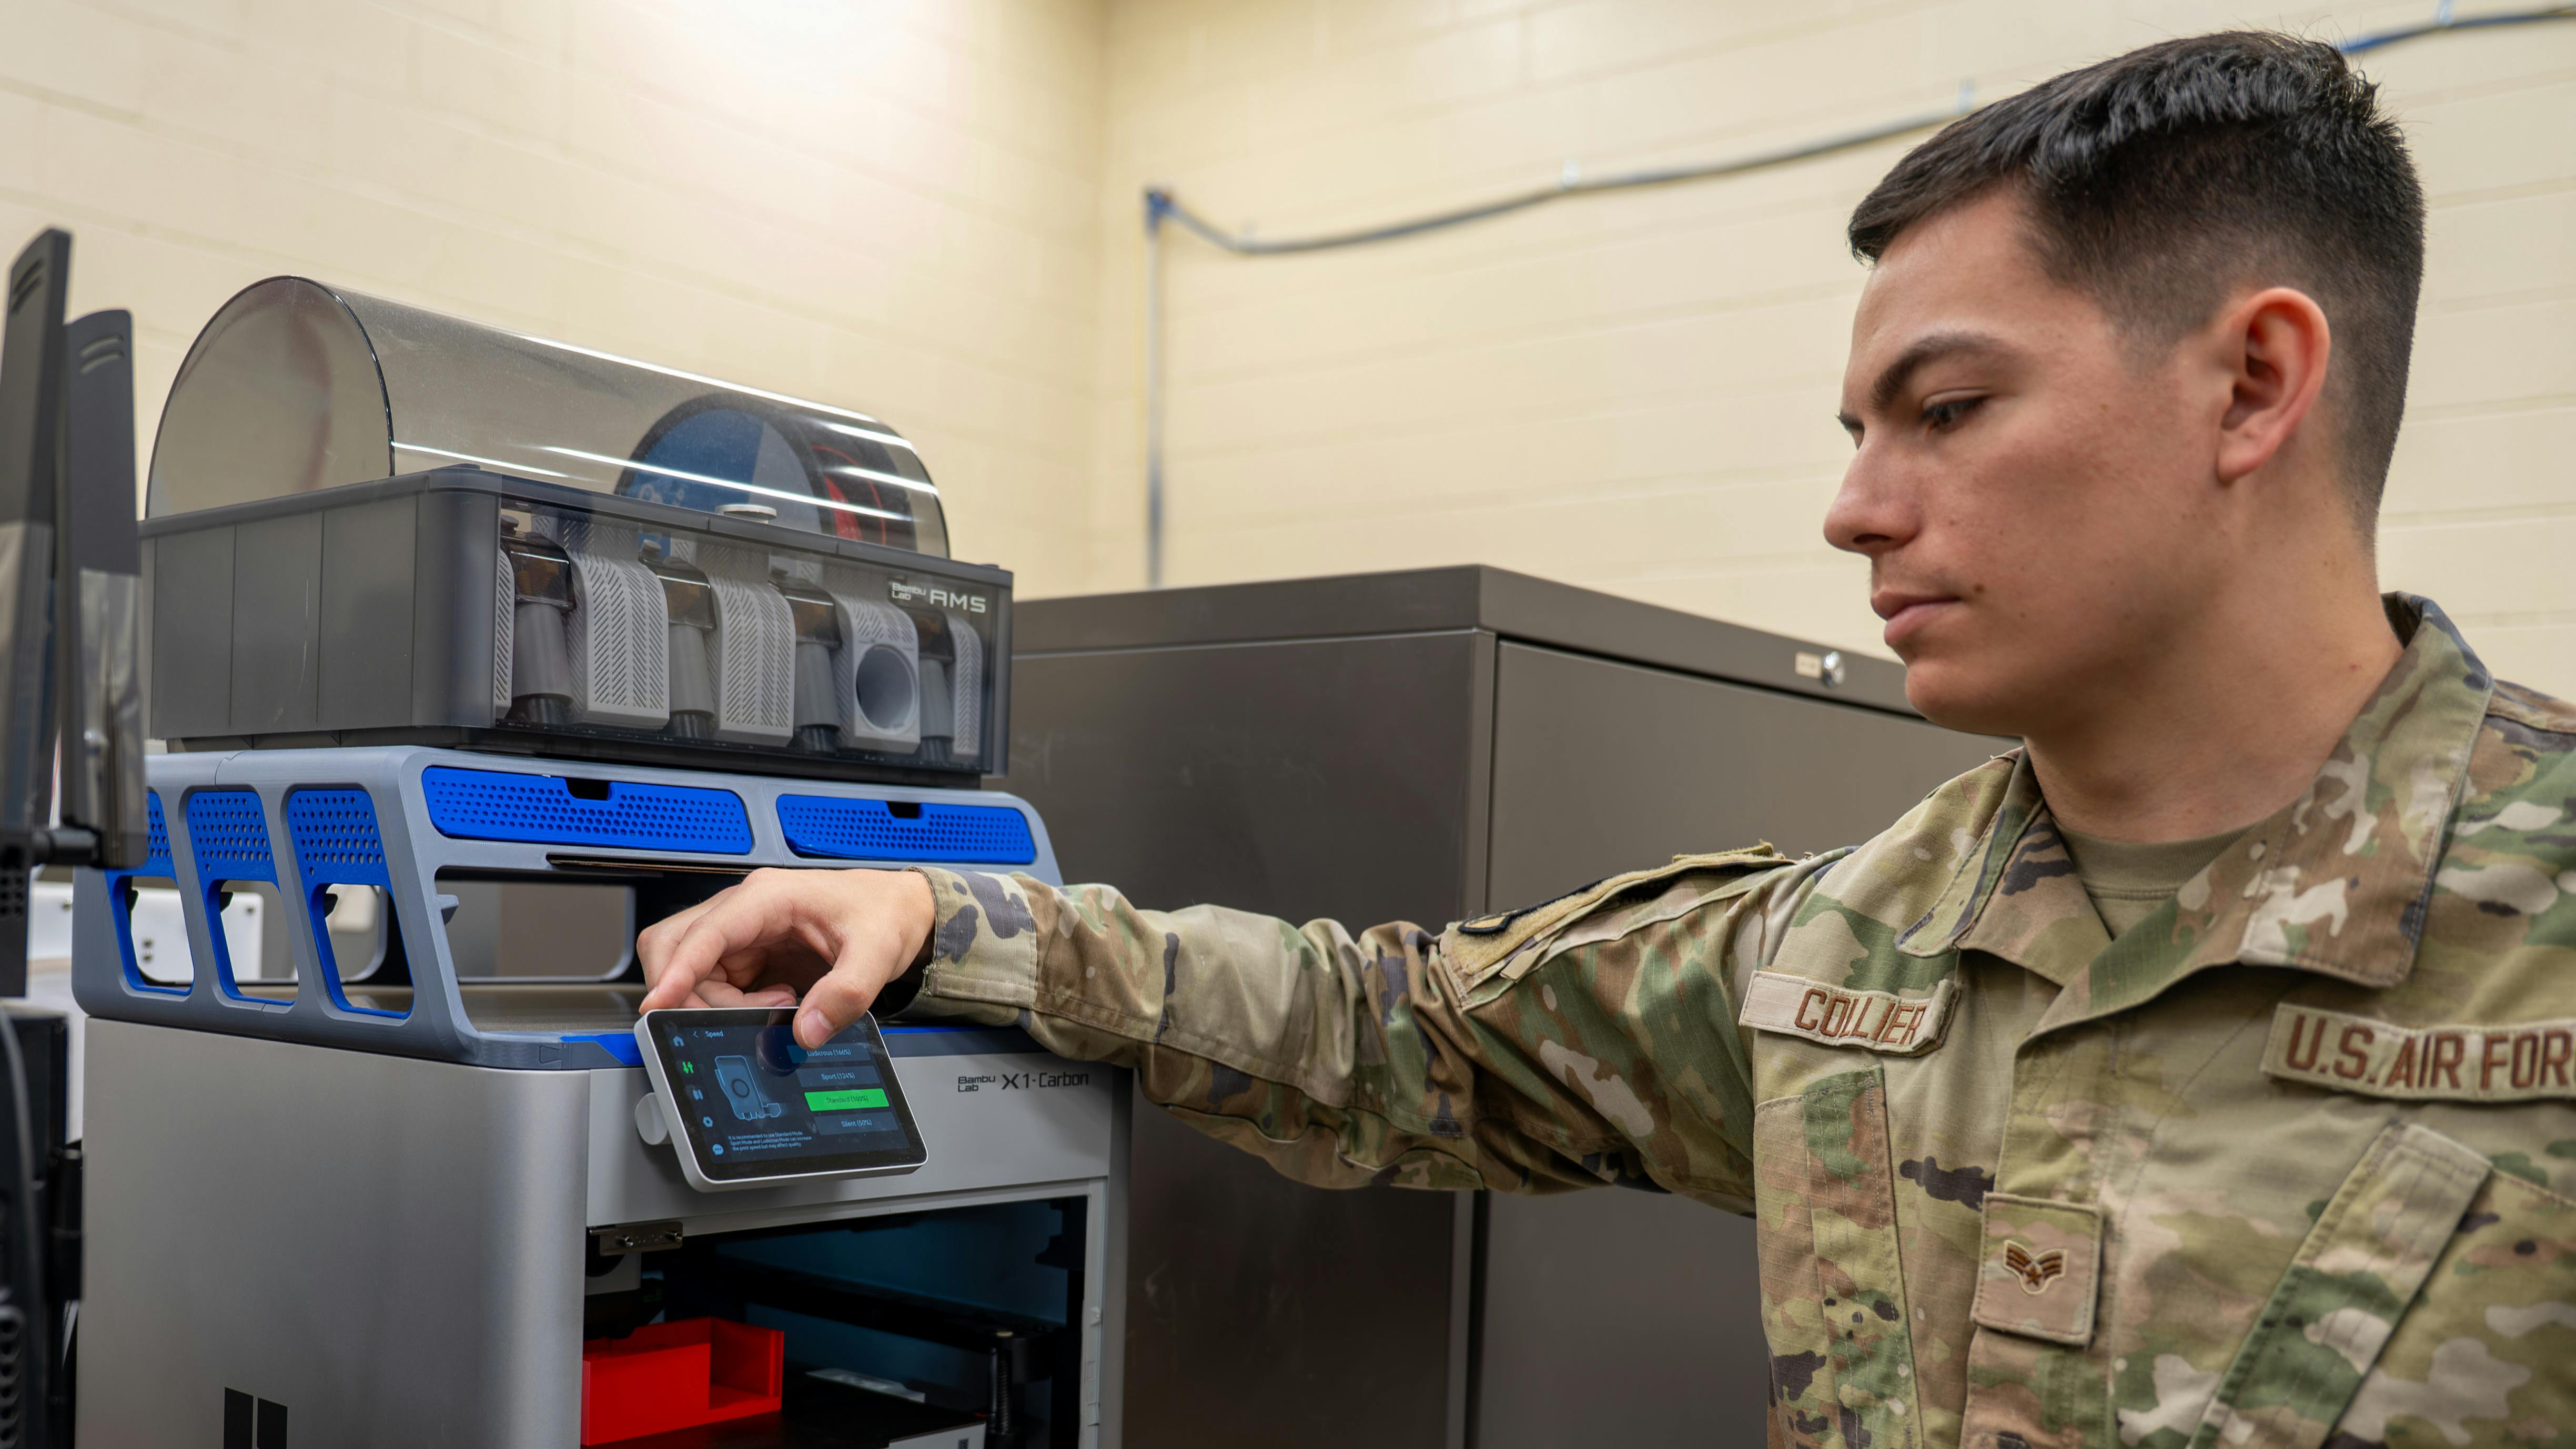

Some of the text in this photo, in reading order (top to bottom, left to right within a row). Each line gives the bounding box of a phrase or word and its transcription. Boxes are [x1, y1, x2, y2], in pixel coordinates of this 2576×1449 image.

[892, 582, 926, 596] Bambu
[892, 590, 911, 601] Lab
[930, 590, 986, 613] AMS
[1794, 988, 1927, 1045] COLLIER
[2286, 1014, 2576, 1090] U.S. AIR FOR
[958, 1075, 995, 1083] Bambu
